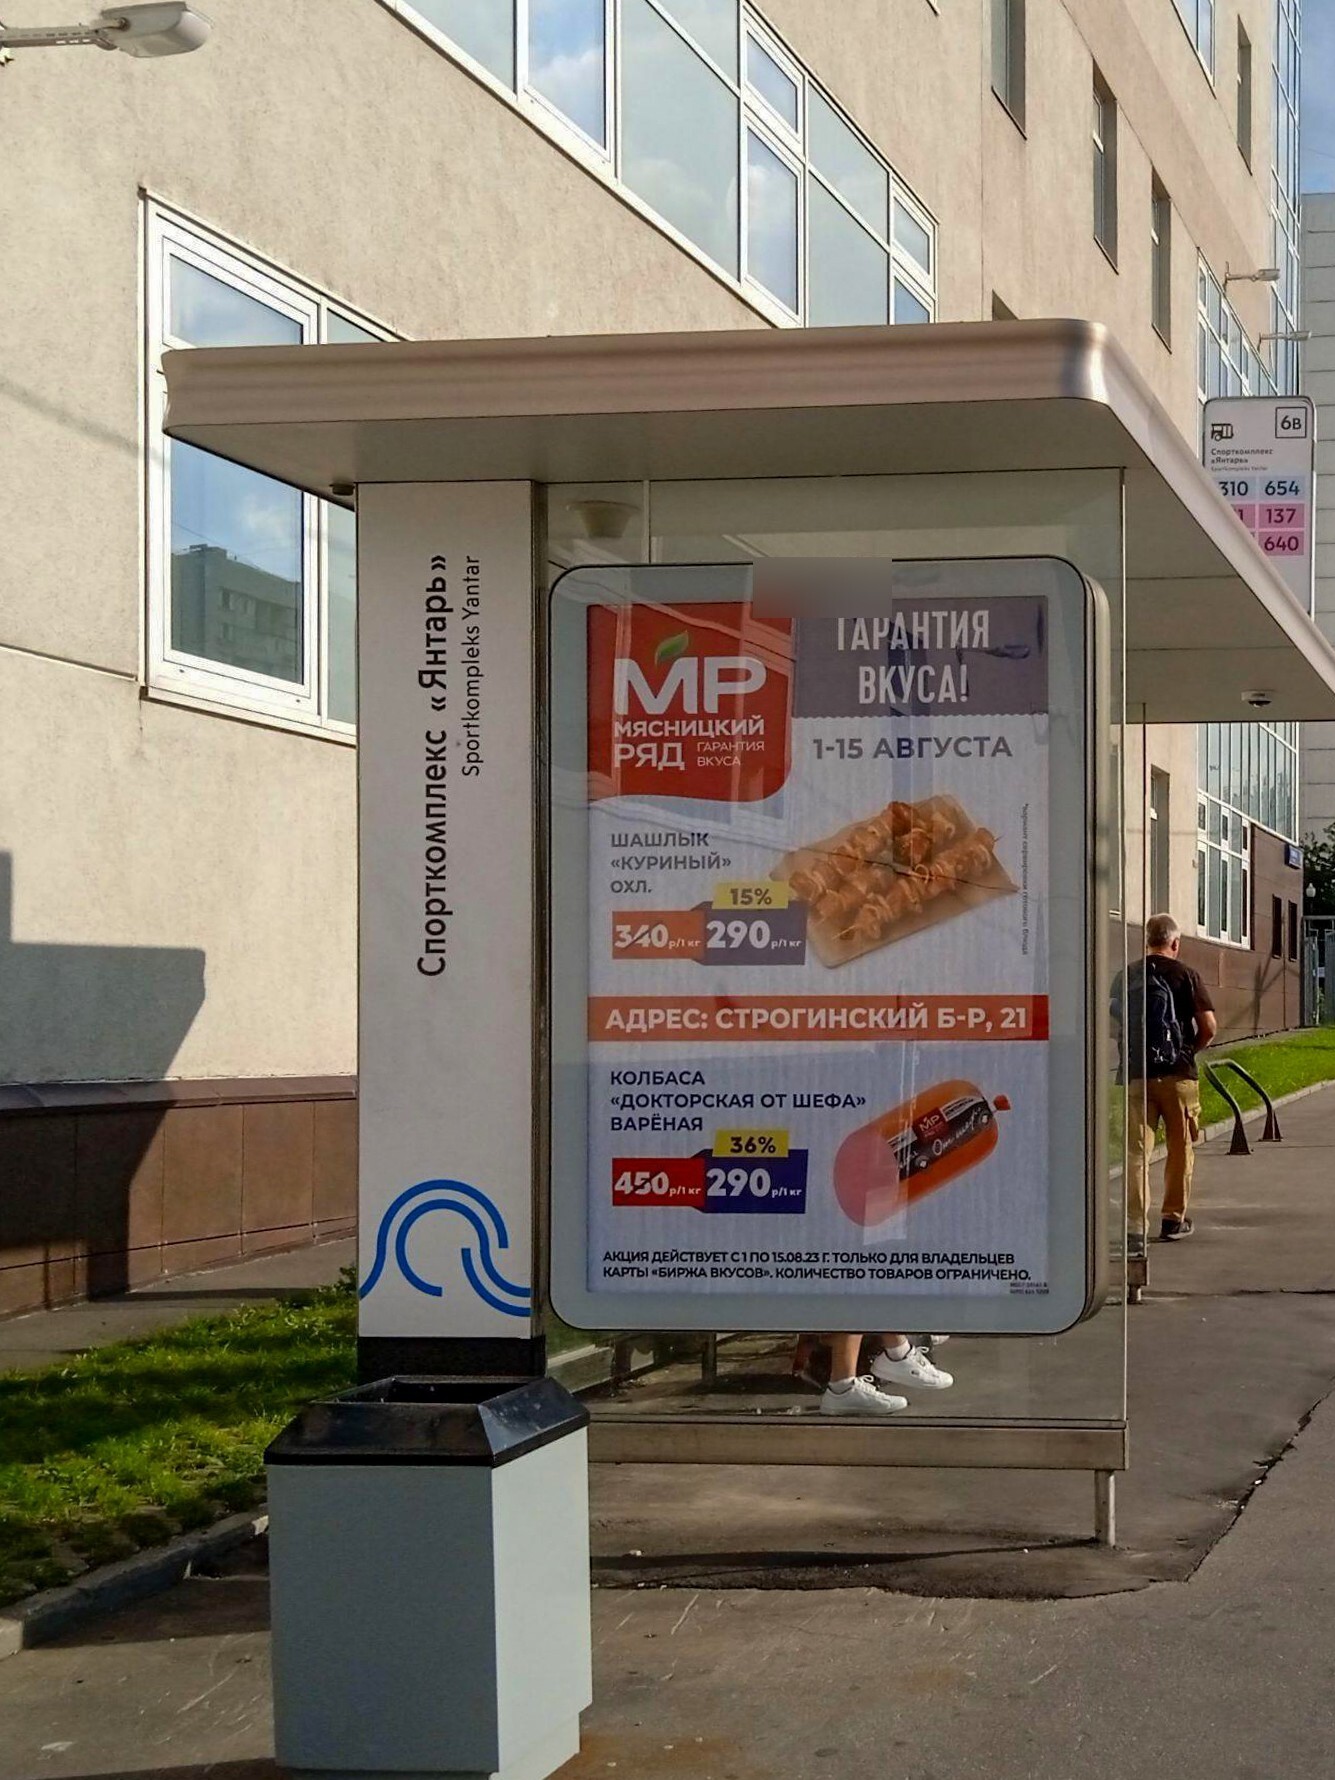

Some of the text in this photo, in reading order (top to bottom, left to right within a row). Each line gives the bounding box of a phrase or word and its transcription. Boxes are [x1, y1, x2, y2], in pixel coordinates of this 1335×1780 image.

[1218, 481, 1300, 496] 310 654
[1266, 508, 1296, 524] 137
[1264, 535, 1300, 551] 640
[462, 555, 484, 777] Sportkompleks Yantar
[858, 663, 968, 705] ВКУСА!
[614, 714, 765, 738] МЯСНИЦКИЙ
[697, 740, 765, 753] ГАРАНТИЯ
[812, 735, 1013, 760] 1-15 АВГУСТА
[418, 554, 454, 977] Спорткомплекс «Янтарь»
[614, 742, 686, 771] РЯД
[697, 755, 741, 767] ВКУСА
[610, 832, 710, 850] ШАШЛЫК
[610, 852, 732, 871] «КУРИНЫЙ»
[610, 880, 652, 894] ОХЛ.
[729, 888, 772, 905] 15%
[605, 1002, 1027, 1033] АДРЕС: СТРОГИНСКИЙ Б-Р, 21
[610, 1070, 706, 1087] КОЛБАСА
[610, 1092, 867, 1111] «ДОКТОРСКАЯ ОТ ШЕФА»
[610, 1112, 704, 1132] ВАРЁНАЯ
[730, 1136, 777, 1154] 36%
[603, 1251, 649, 1264] АКЦИЯ
[652, 1249, 728, 1264] ДЕЙСТВУЕТ
[750, 1251, 770, 1263] ПО
[772, 1251, 820, 1263] 15.08.23
[832, 1252, 888, 1264] ТОЛЬКО
[889, 1252, 919, 1265] ДЛЯ
[922, 1253, 1015, 1266] ВЛАДЕЛЬЦЕВ
[603, 1266, 1032, 1281] КАРТЫ «БИРЖА ВКУСОВ». КОЛИЧЕСТВО ТОВАРОВ ОГРАНИЧЕНО.
